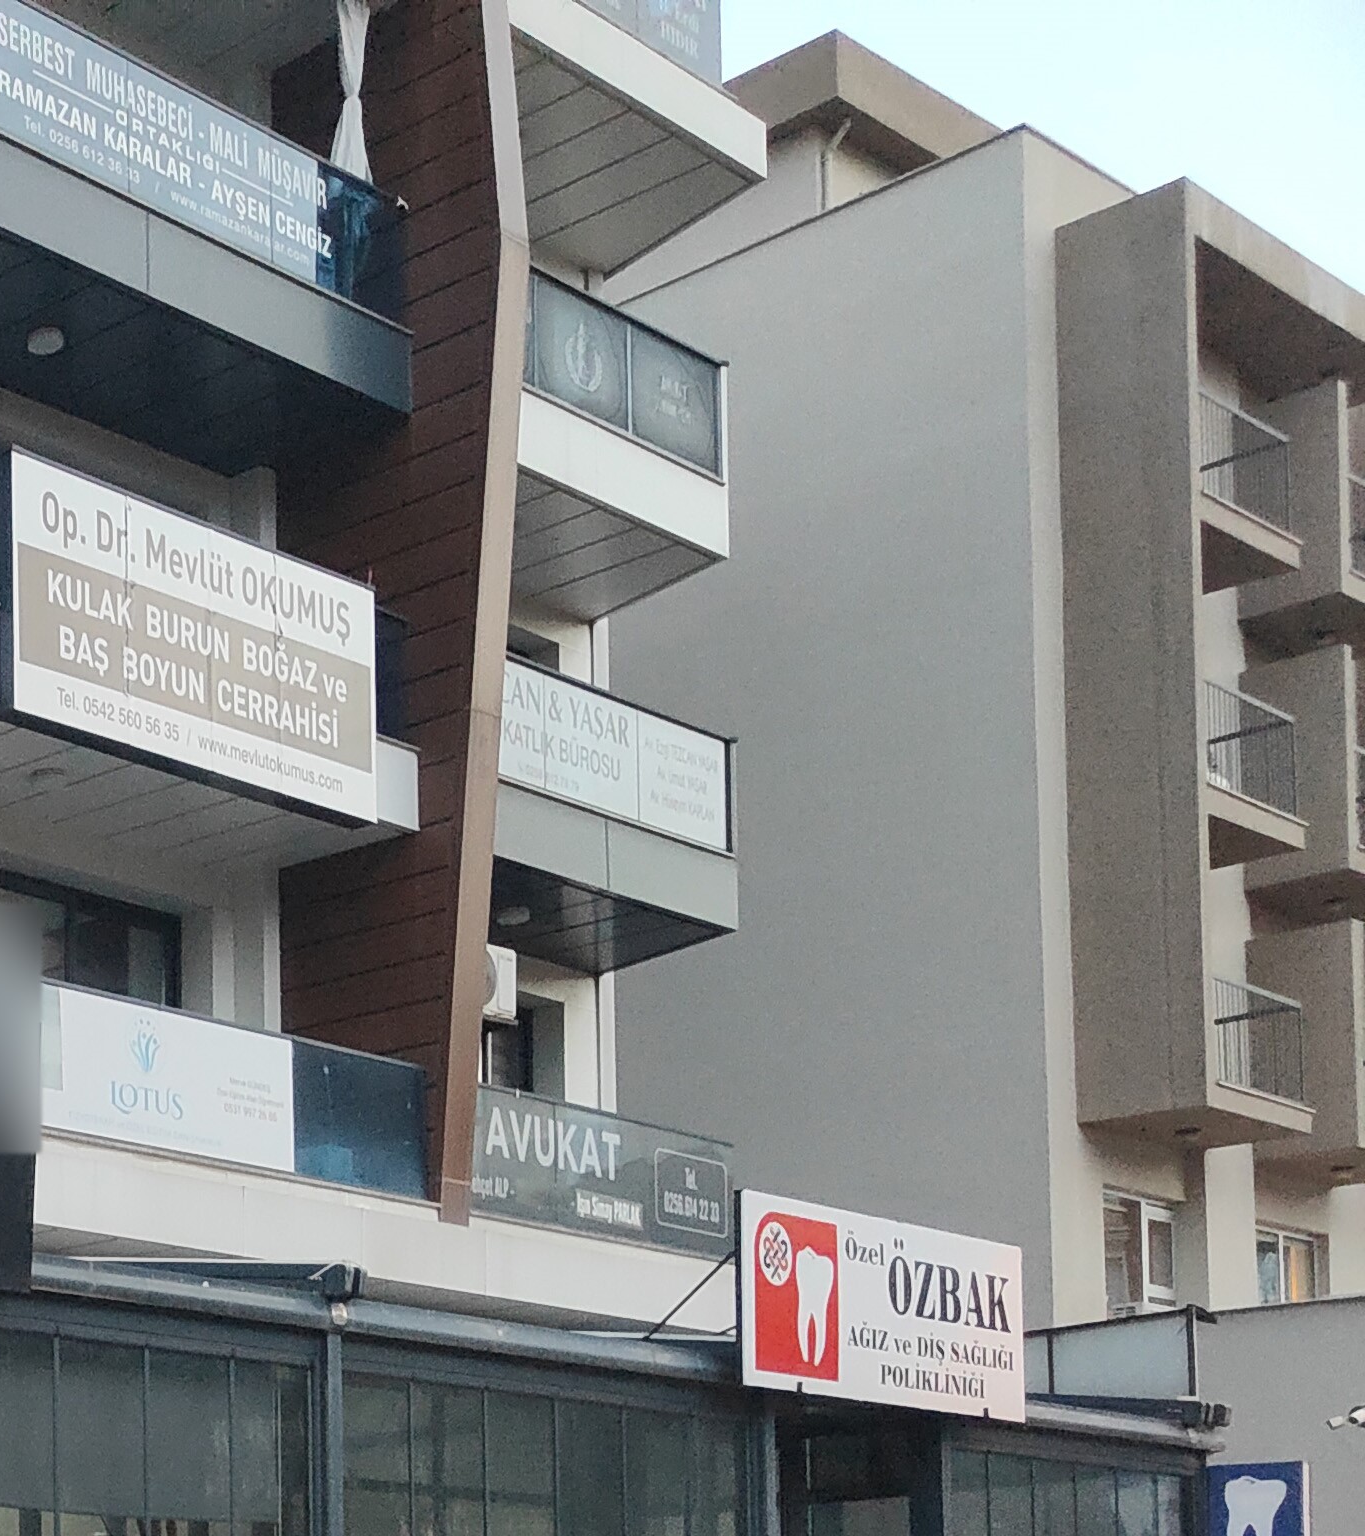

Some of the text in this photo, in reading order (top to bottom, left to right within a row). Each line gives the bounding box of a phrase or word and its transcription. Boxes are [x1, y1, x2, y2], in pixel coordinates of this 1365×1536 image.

[23, 114, 45, 138] Tel.
[49, 129, 79, 154] 0256
[82, 146, 105, 167] 612
[86, 58, 193, 142] MUHASEBECİ
[210, 122, 248, 170] MALİ
[115, 109, 220, 175] ORTAKLIĞI
[104, 123, 192, 189] KARALAR
[211, 180, 271, 227] AYŞEN
[275, 211, 333, 259] CENGİZ
[42, 491, 351, 647] Op. Dr. Mevlüt OKUMUŞ
[47, 568, 348, 703] KULAK BURUN BOĞAZ ve
[59, 624, 339, 748] BAŞ BOYUN CERRAHİSİ
[548, 690, 563, 724] &
[568, 696, 630, 749] YAŞAR
[57, 686, 79, 711] Tel.
[83, 695, 115, 722] 0542
[119, 708, 142, 730] 560
[145, 716, 161, 736] 56
[164, 722, 180, 742] 35
[198, 735, 343, 793] www.mevlutokumus.com
[559, 734, 622, 782] BÜROSU
[110, 1080, 184, 1121] LOTUS
[485, 1106, 622, 1181] AVUKAT
[845, 1229, 1012, 1334] Özel ÖZBAK
[847, 1321, 1014, 1372] AĞIZ ve DİŞ SAĞLIĞI
[880, 1363, 986, 1399] POLİKLİNİĞİ
